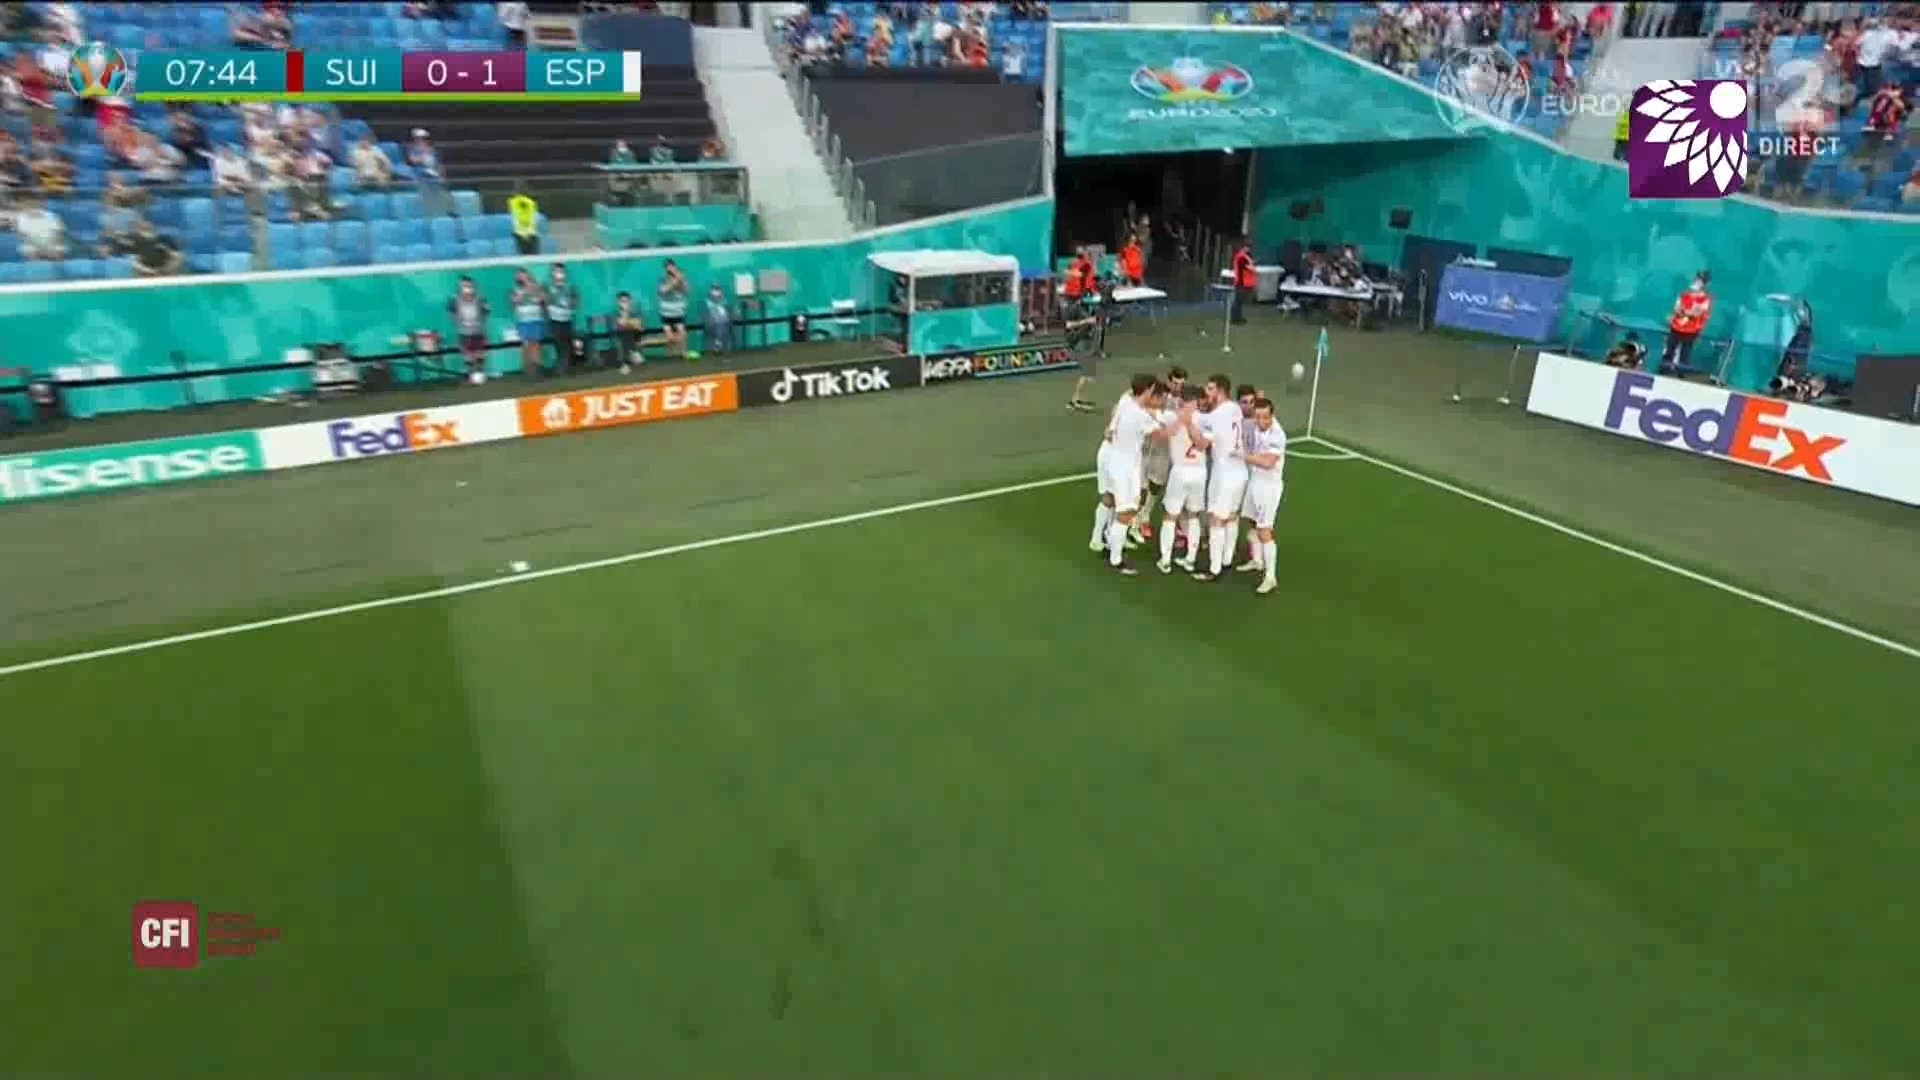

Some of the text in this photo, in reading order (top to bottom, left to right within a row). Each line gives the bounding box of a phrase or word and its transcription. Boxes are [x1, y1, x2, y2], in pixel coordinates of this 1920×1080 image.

[1448, 290, 1488, 306] vivo
[580, 382, 717, 425] JUST EAT
[800, 366, 891, 399] TikTok
[327, 413, 459, 458] FedEx
[1604, 370, 1847, 482] FedEx
